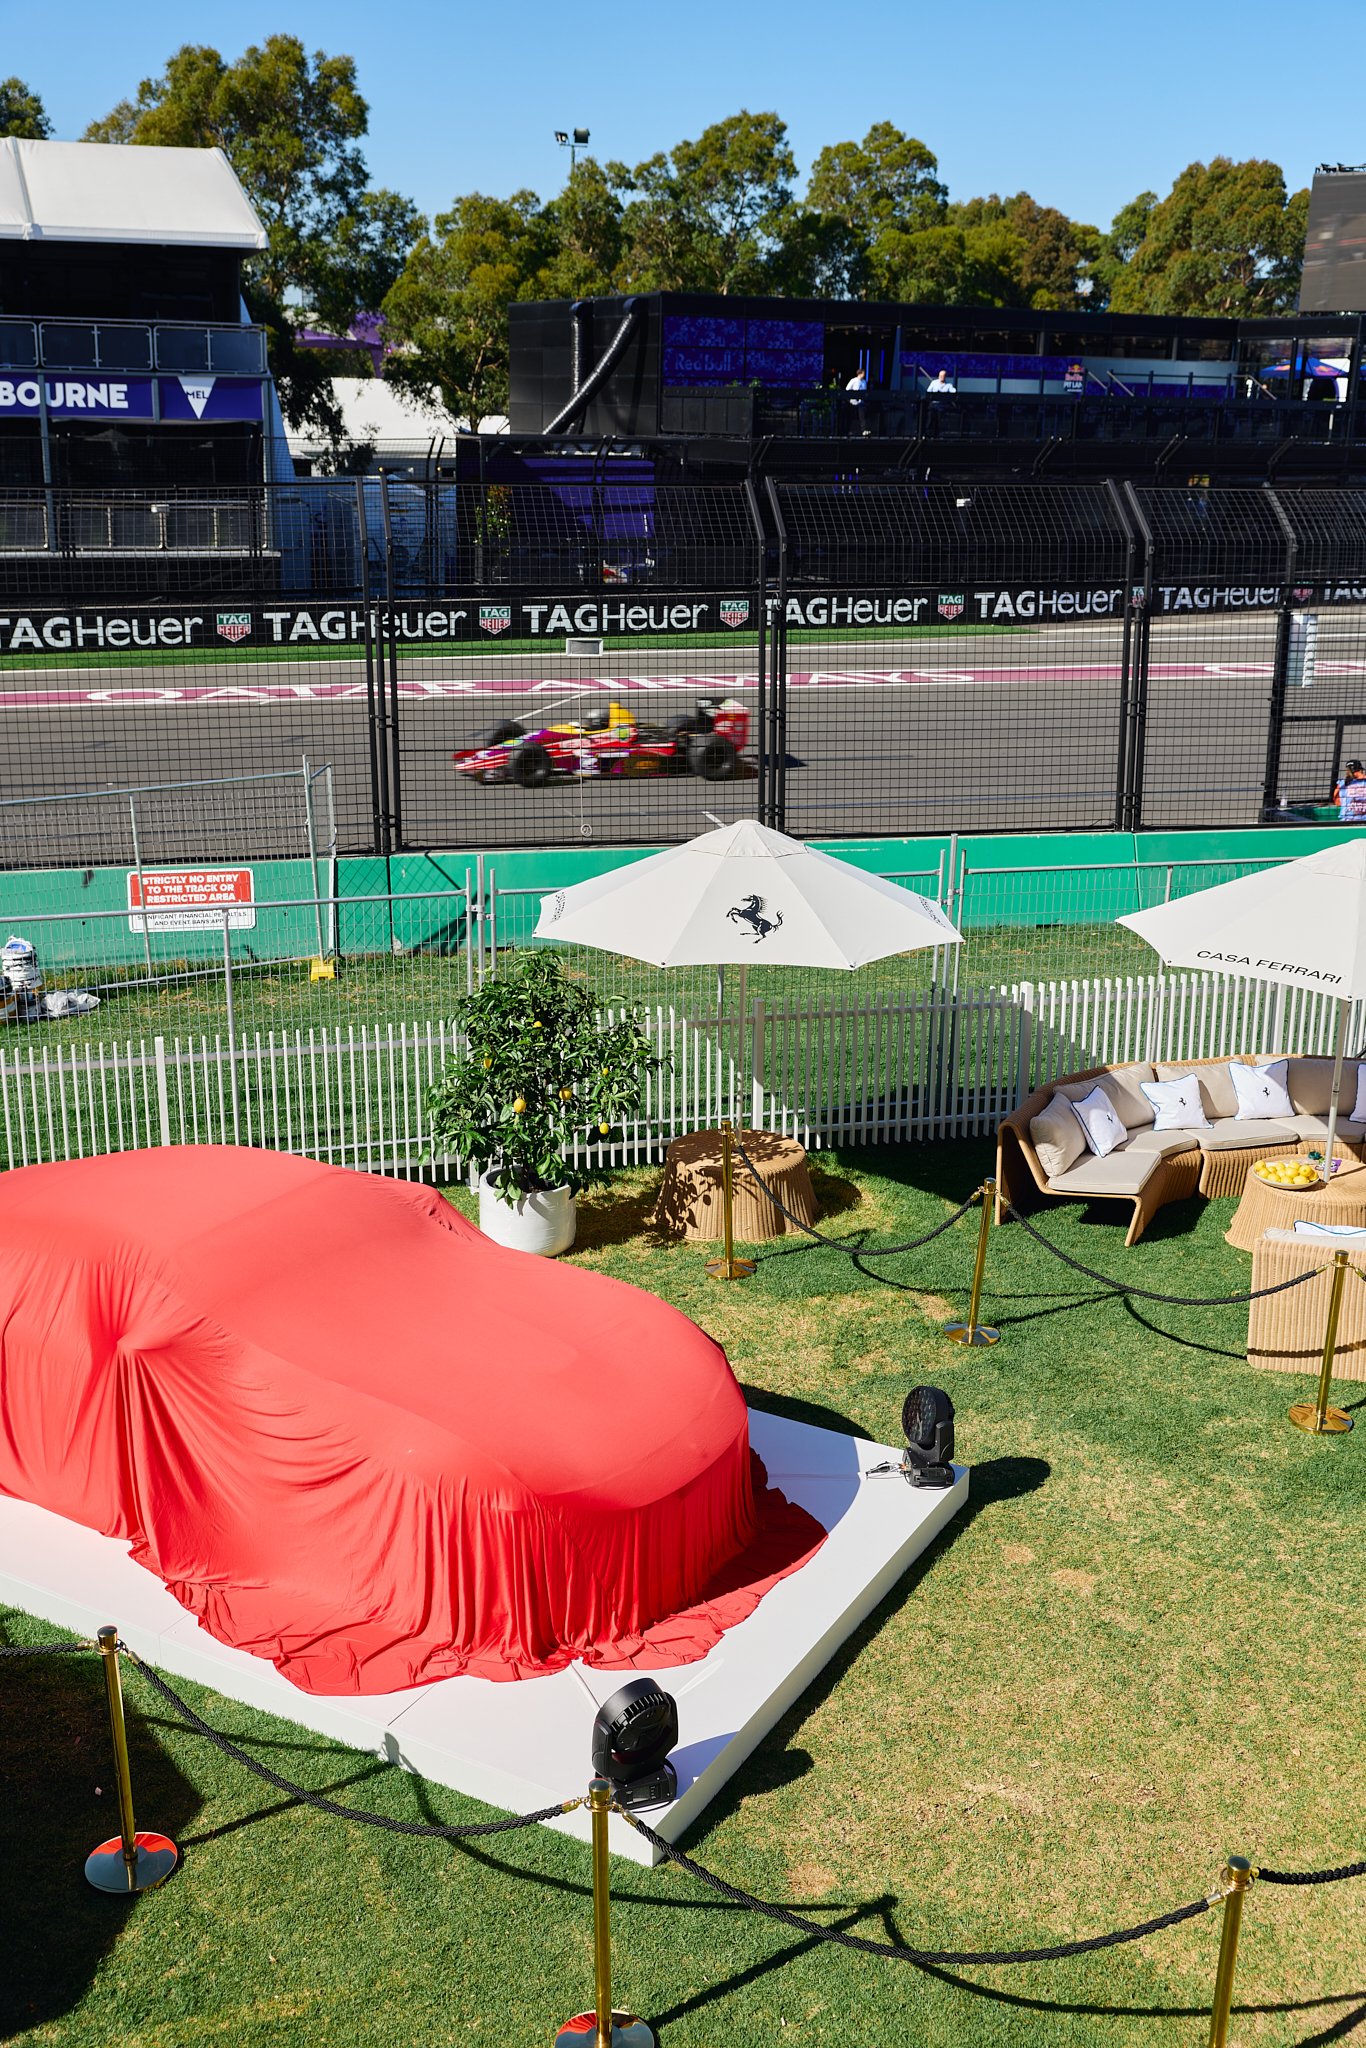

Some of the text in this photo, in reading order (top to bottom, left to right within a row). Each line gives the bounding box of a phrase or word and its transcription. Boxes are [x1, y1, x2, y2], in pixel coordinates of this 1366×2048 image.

[0, 381, 129, 409] BOURNE
[186, 390, 208, 399] MEL
[940, 595, 962, 605] TAG
[722, 602, 747, 611] TAG
[482, 608, 508, 618] TAG
[220, 615, 248, 625] TAG
[142, 874, 239, 885] STRICTLY NO ENTRY
[147, 884, 234, 894] TO THE TRACK OR
[146, 893, 236, 904] RESTRICTED AREA
[137, 912, 178, 920] SINIFICANT
[1196, 950, 1343, 985] CASA FERRARI
